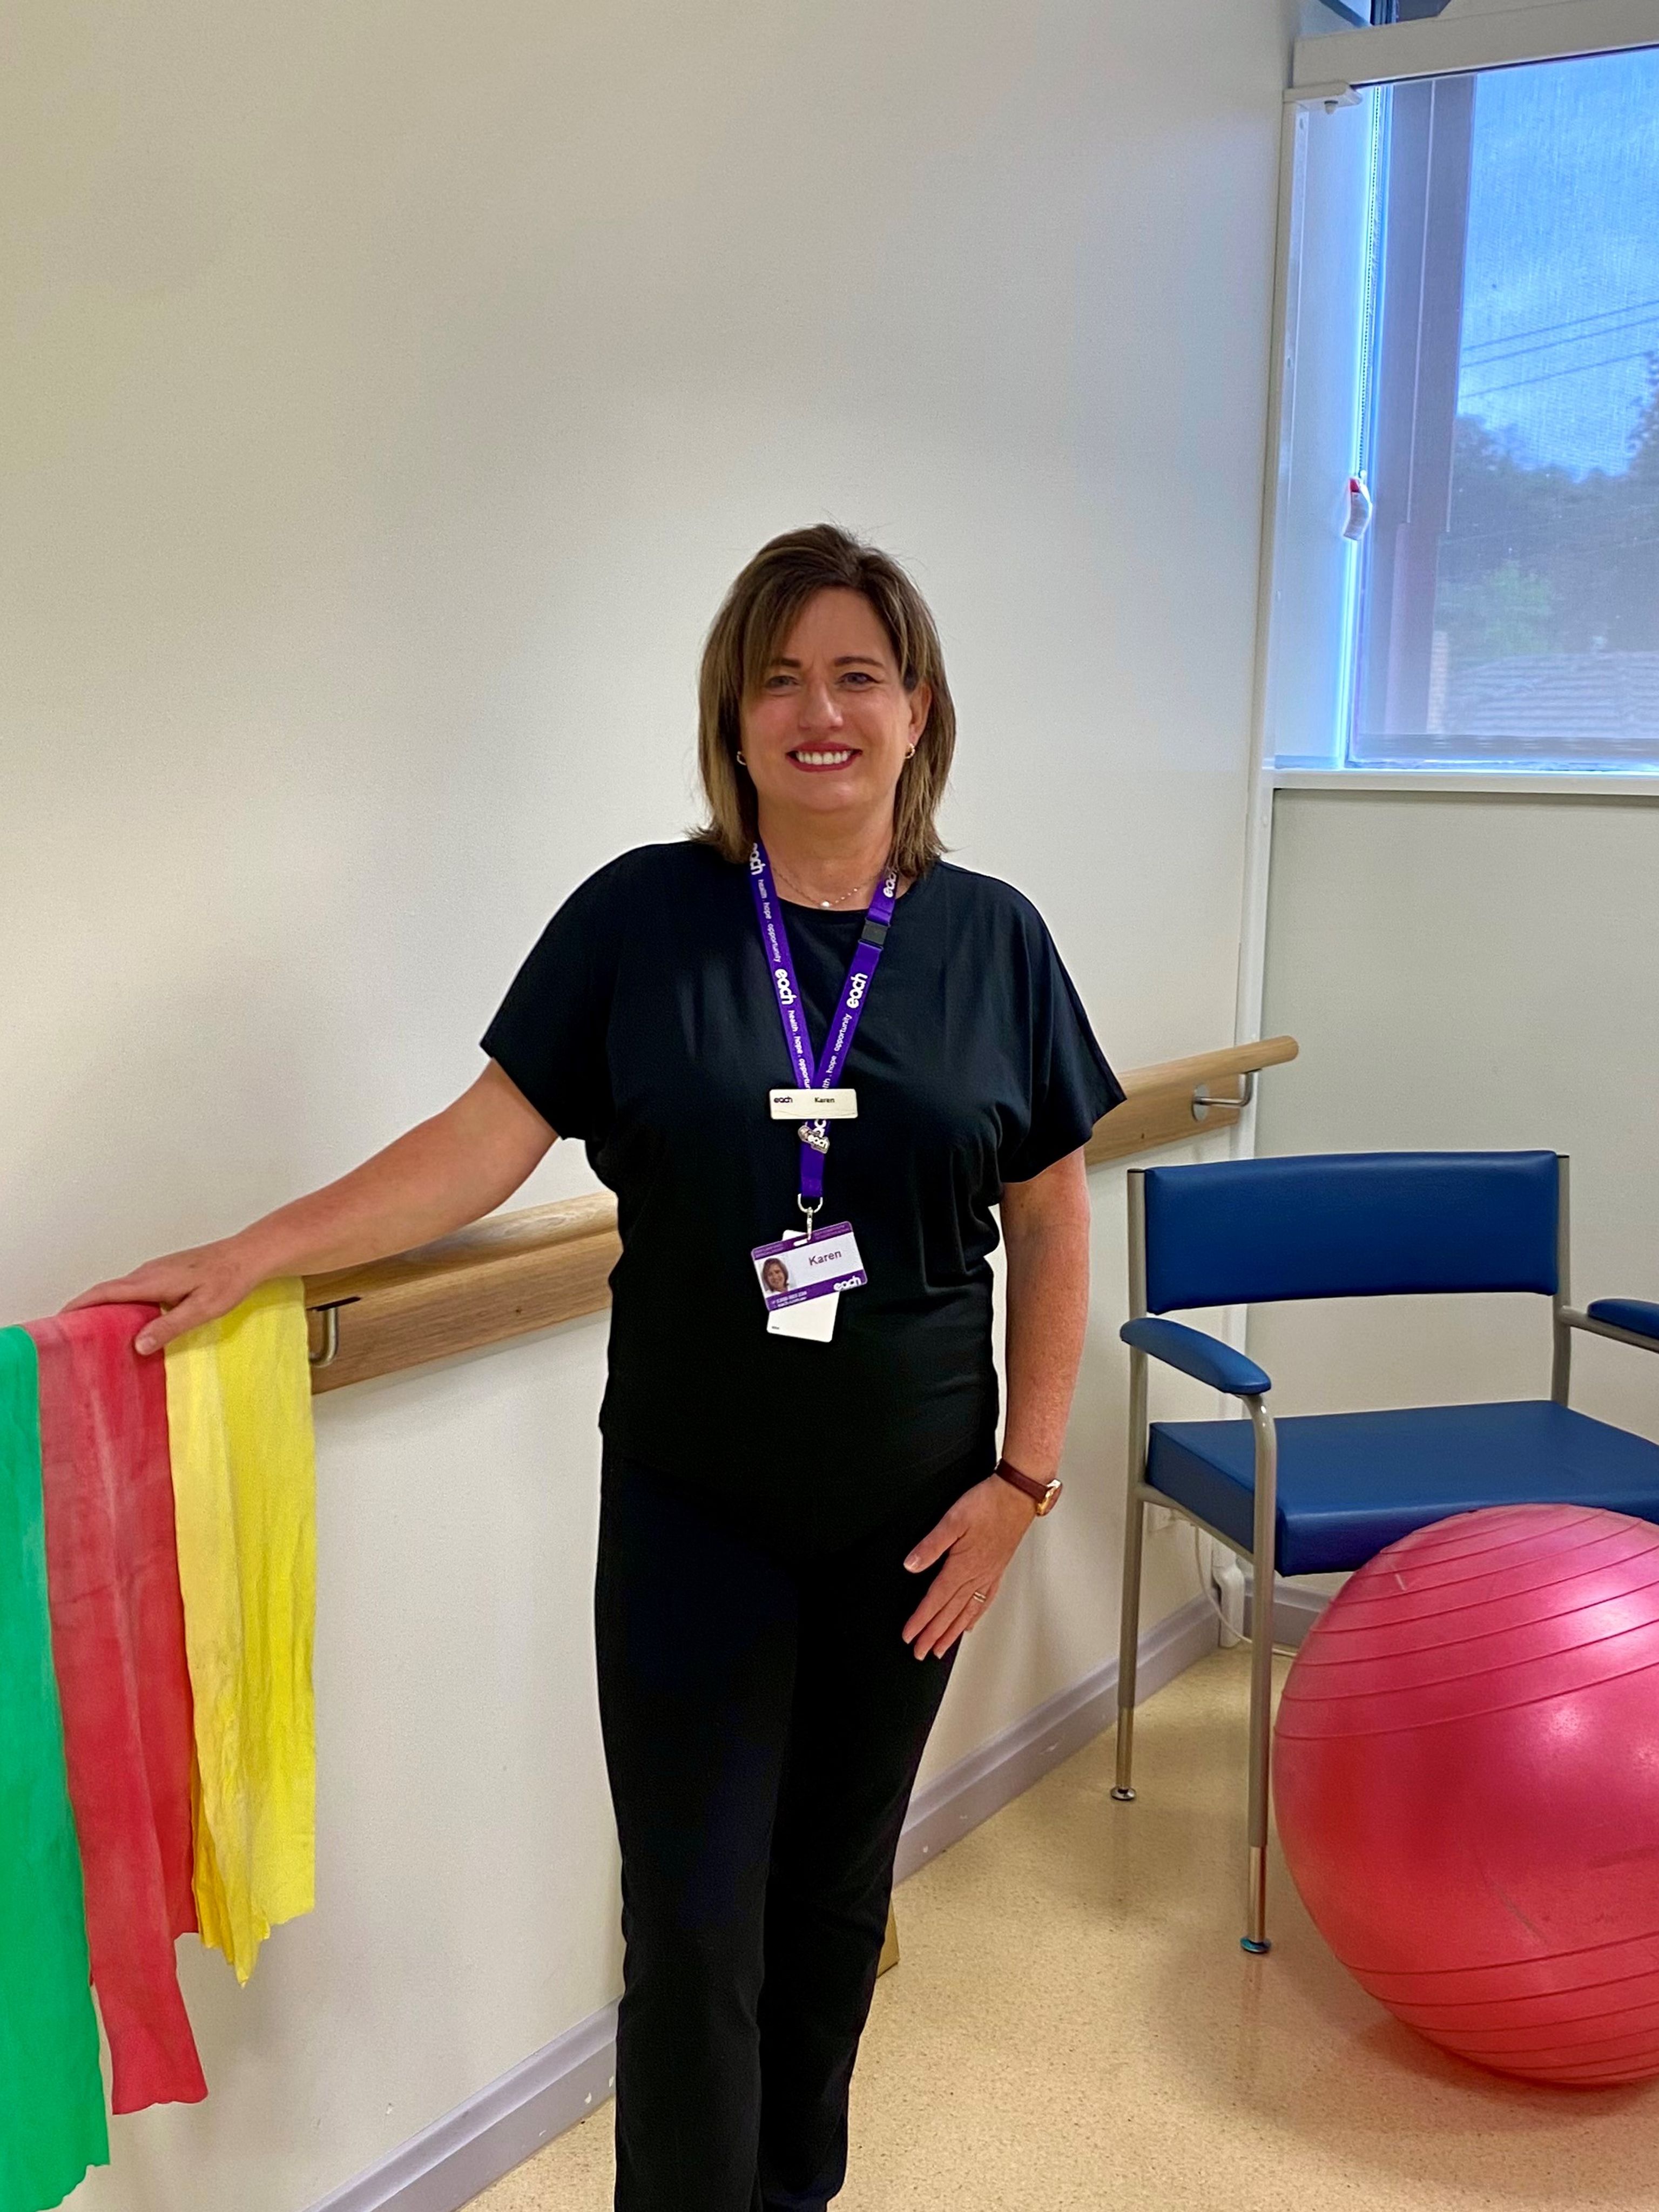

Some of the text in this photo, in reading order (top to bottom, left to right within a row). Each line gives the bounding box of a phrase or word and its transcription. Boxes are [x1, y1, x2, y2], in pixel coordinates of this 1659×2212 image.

[883, 871, 896, 898] eac
[758, 879, 781, 962] health hope opportunity
[775, 969, 797, 1004] each
[847, 973, 868, 1008] each
[788, 1010, 798, 1032] health
[794, 1036, 803, 1054] hope
[826, 1055, 837, 1074] hope
[834, 1013, 852, 1051] opportunity
[808, 1251, 842, 1266] Karen
[833, 1276, 862, 1291] each
